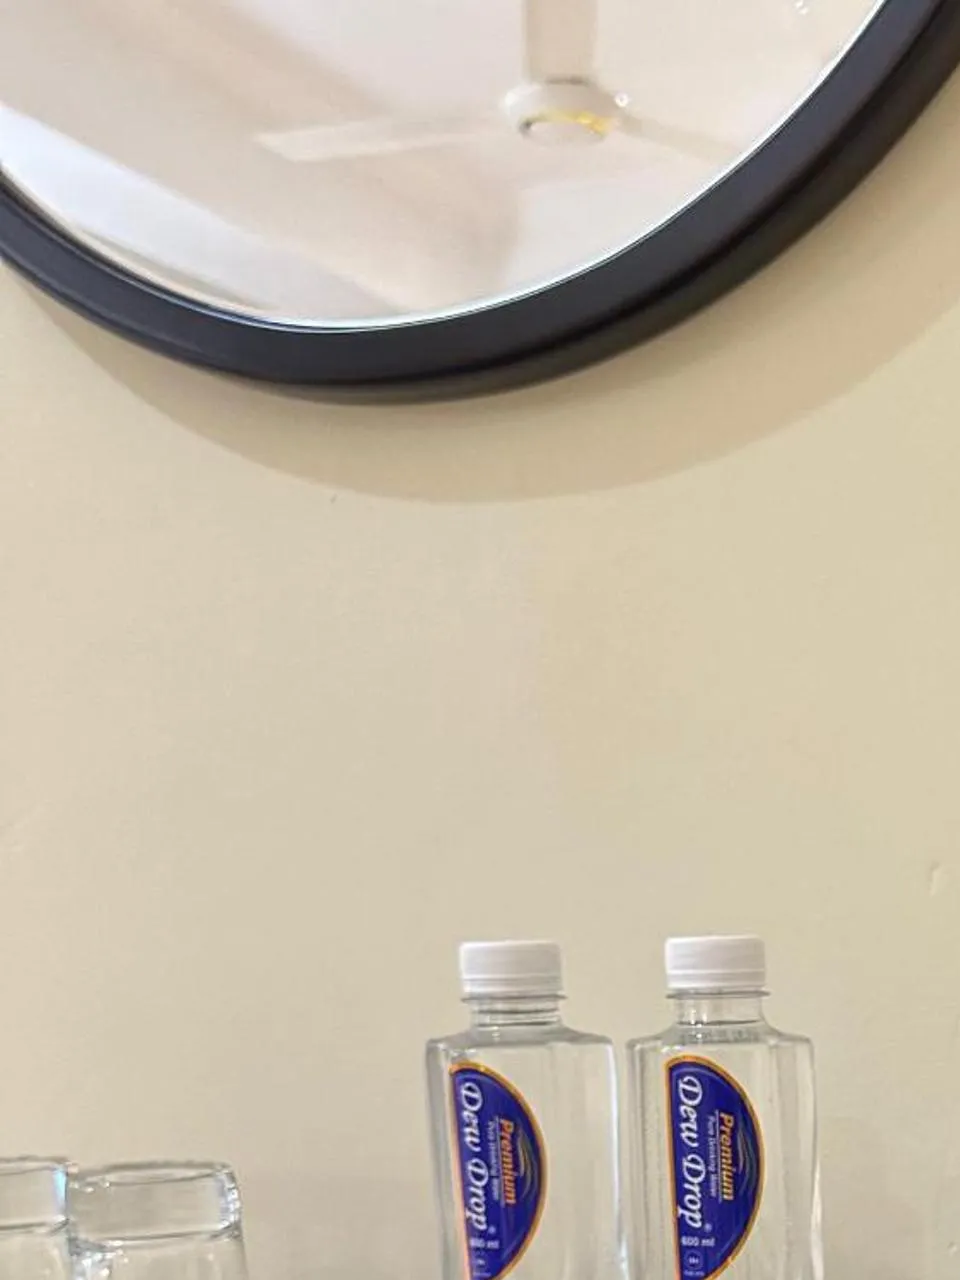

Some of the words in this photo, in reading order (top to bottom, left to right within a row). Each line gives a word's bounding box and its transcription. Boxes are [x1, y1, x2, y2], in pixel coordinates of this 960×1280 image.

[461, 1082, 483, 1151] Dew
[678, 1075, 703, 1147] Dew
[501, 1118, 517, 1205] Premium
[678, 1154, 706, 1229] Drop
[720, 1112, 735, 1200] Premium
[465, 1158, 489, 1230] Drop
